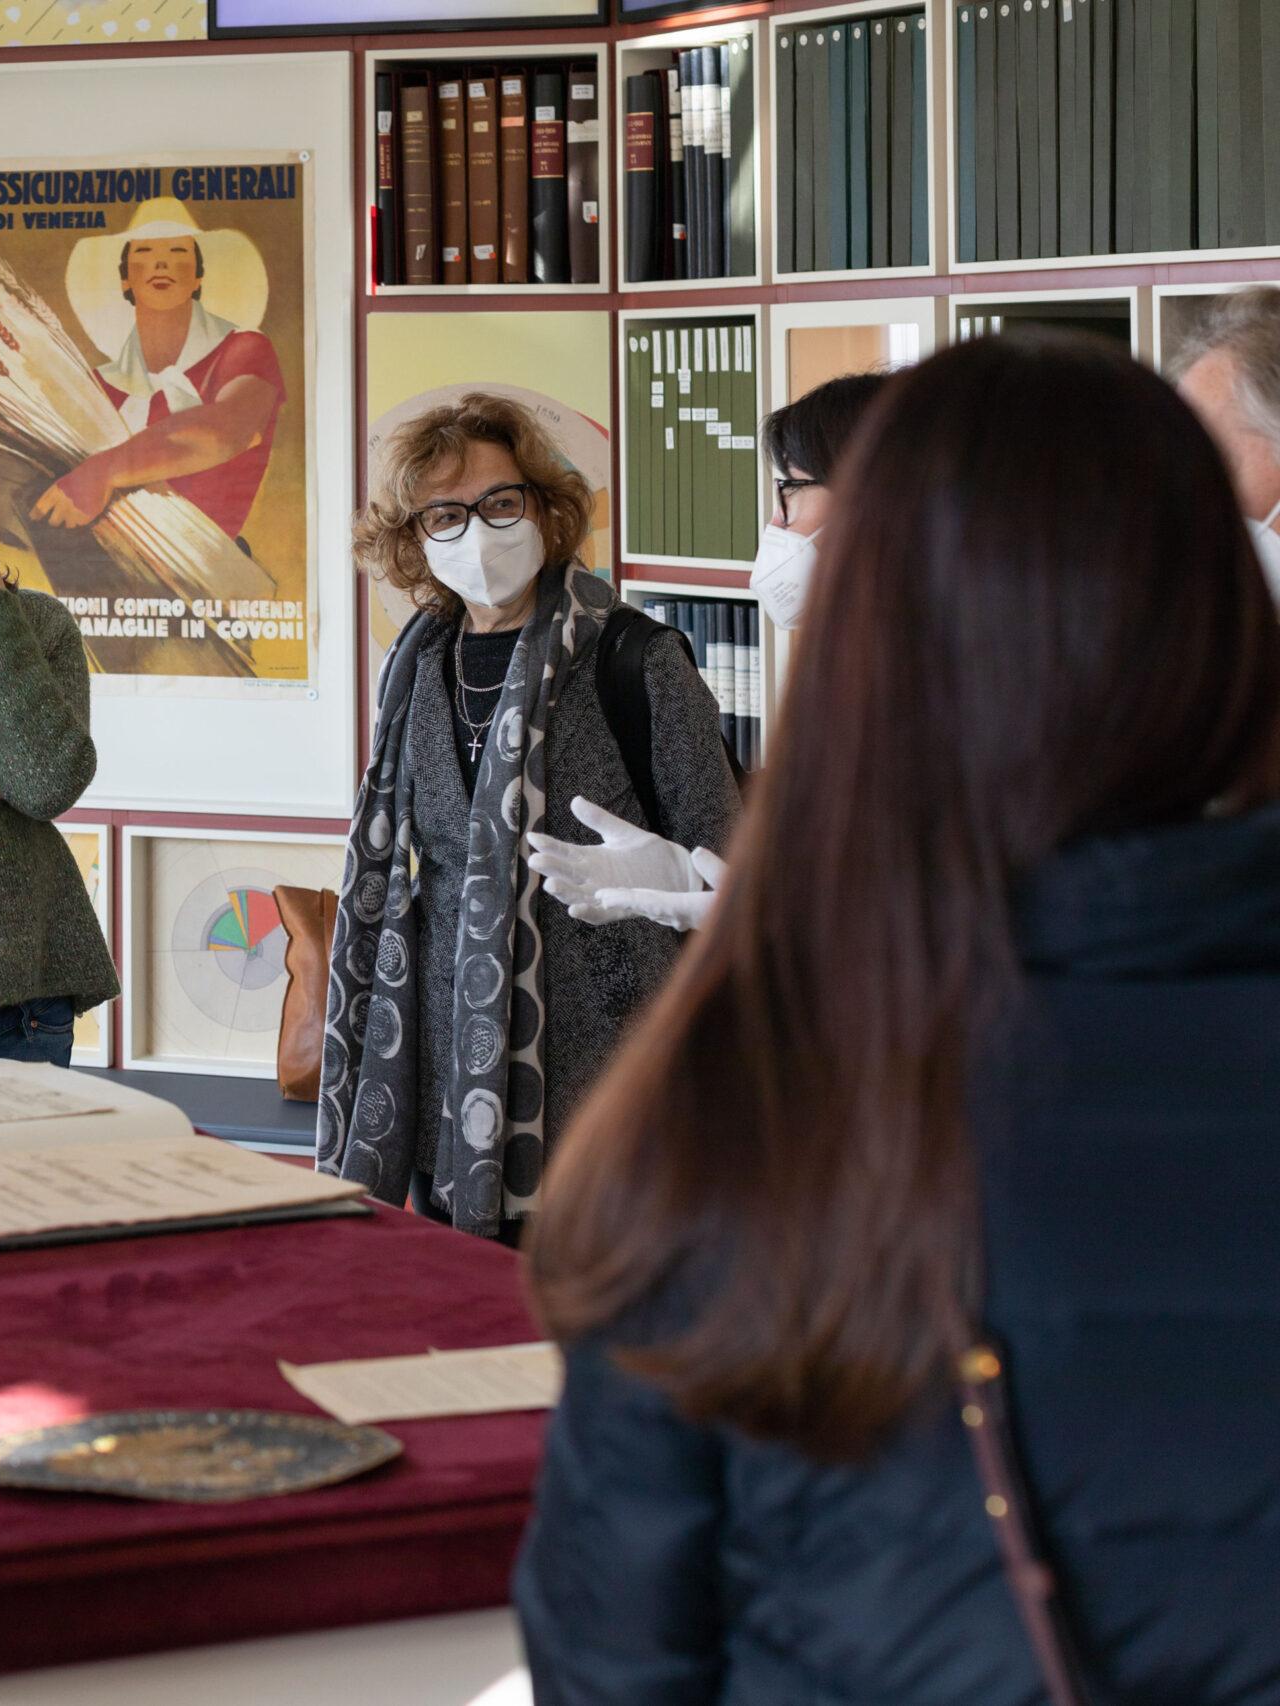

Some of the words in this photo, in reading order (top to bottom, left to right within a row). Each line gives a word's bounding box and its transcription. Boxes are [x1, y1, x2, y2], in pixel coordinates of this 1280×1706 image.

[172, 166, 296, 201] GENERALI
[23, 211, 106, 229] VENEZIA
[114, 598, 186, 618] CONTRO
[192, 599, 222, 618] GLI
[230, 600, 303, 619] INCENDI
[79, 617, 169, 637] ANAGLIE
[181, 619, 205, 639] IN
[217, 620, 304, 640] COVONI
